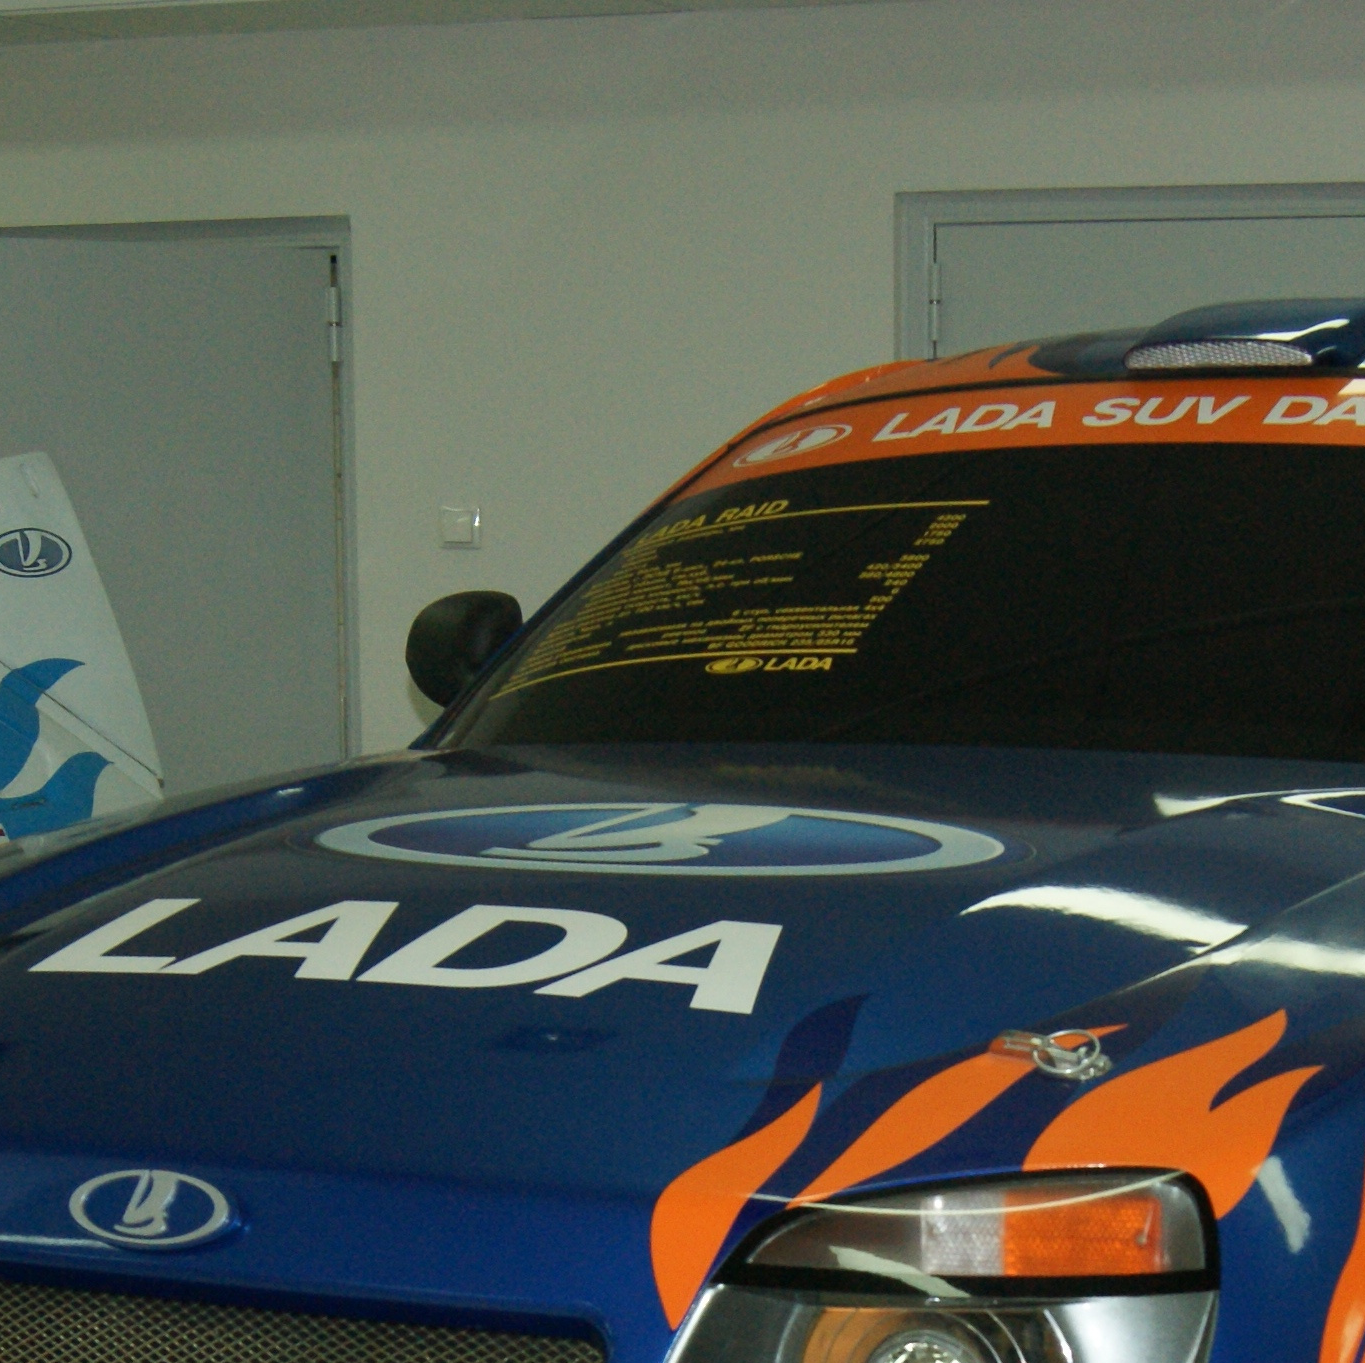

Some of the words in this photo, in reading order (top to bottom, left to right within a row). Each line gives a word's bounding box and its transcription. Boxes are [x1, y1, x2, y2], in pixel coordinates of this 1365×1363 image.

[872, 402, 1059, 441] LADA
[1081, 395, 1251, 428] SUV
[715, 500, 789, 523] RAID
[763, 656, 833, 671] LADA
[28, 898, 783, 1015] LADA
